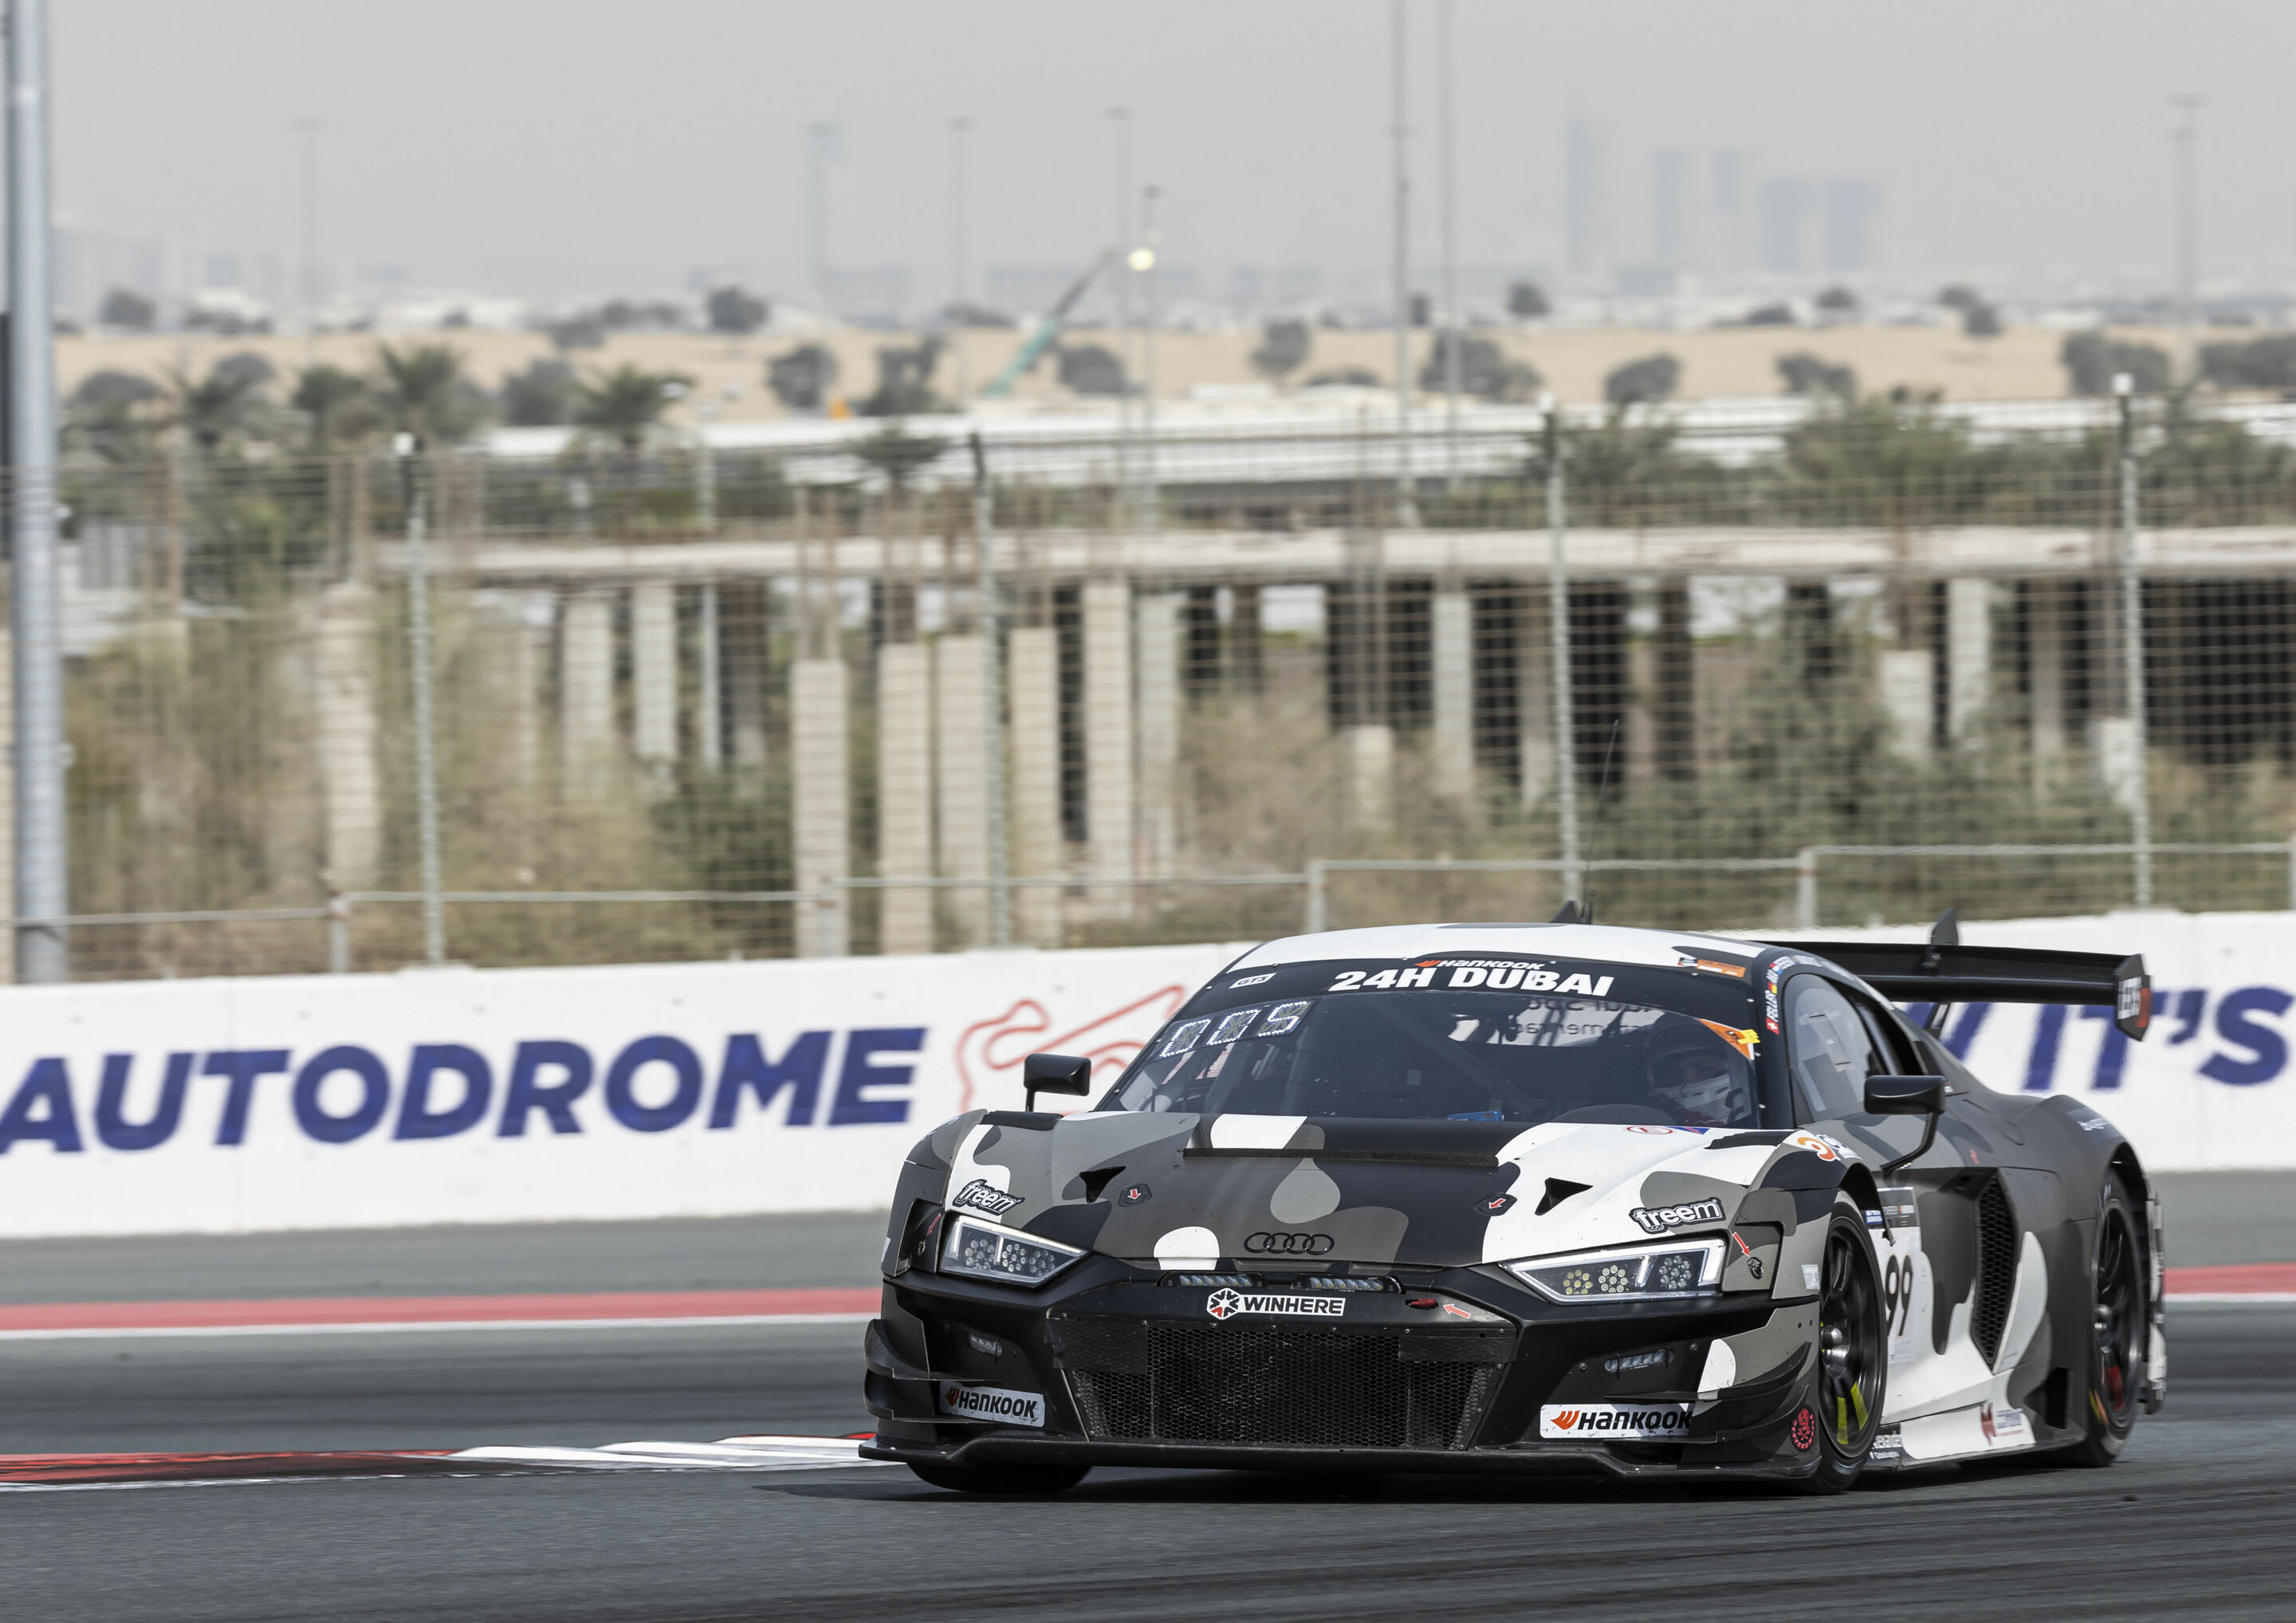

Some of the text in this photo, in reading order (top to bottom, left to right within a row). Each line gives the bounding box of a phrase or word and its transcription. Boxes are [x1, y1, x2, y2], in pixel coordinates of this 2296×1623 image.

[1327, 966, 1615, 997] 24H DUBAI
[2019, 984, 2294, 1089] IT'S
[0, 1026, 930, 1154] AUTODROME
[954, 1180, 1018, 1213] freem
[1634, 1201, 1723, 1231] freem
[1244, 1296, 1343, 1315] WINHERE
[1885, 1254, 1913, 1338] 99
